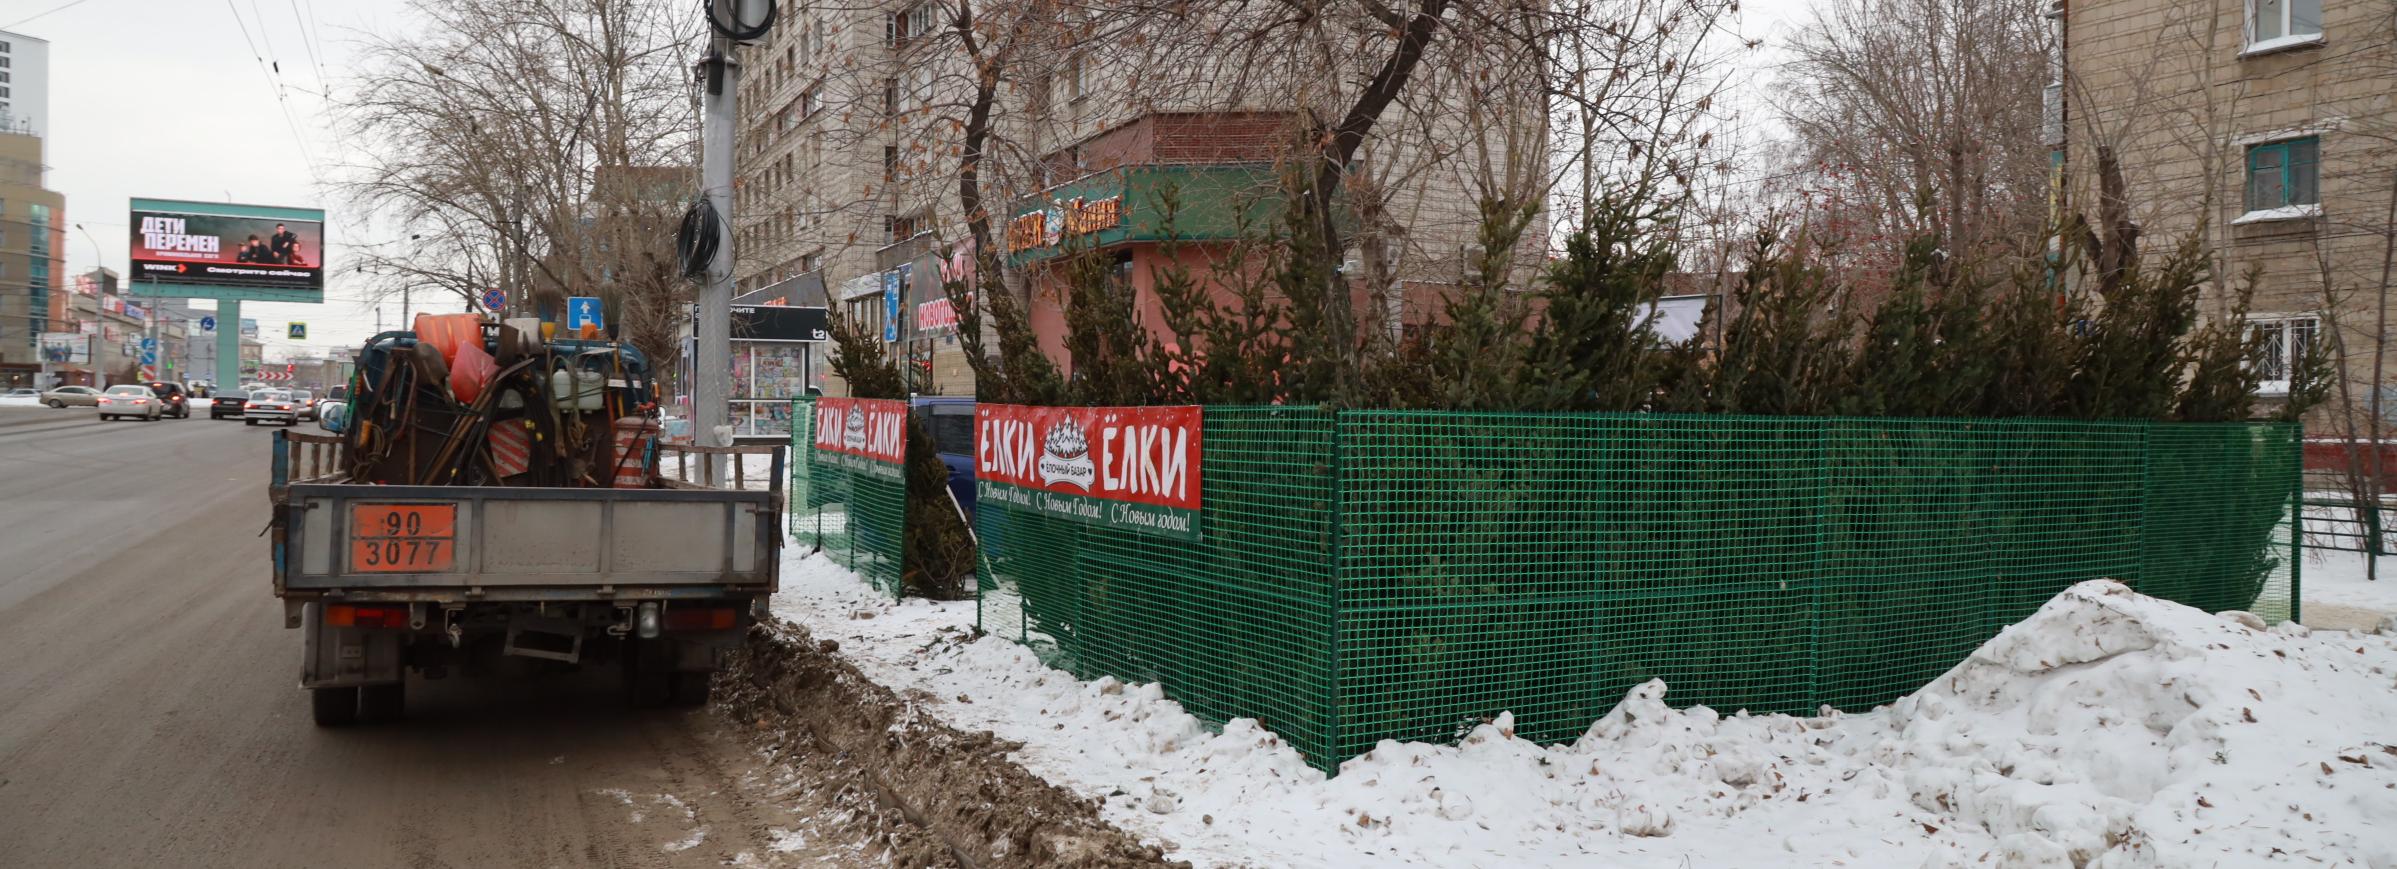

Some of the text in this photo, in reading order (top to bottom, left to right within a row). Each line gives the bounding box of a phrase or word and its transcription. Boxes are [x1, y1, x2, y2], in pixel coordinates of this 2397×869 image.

[140, 216, 186, 235] ДЕТИ
[144, 233, 220, 253] ПЕРЕМЕН
[143, 263, 178, 272] WINK
[206, 266, 311, 277] Смотрите сейчас
[812, 328, 825, 340] t2
[816, 400, 901, 459] ЁЛКИ ЁЛКИ
[980, 409, 1187, 502] ЁЛКИ ЁЛКИ
[1070, 463, 1087, 478] БАЗАР
[978, 481, 984, 499] С
[1036, 492, 1044, 511] С
[1043, 495, 1072, 515] Новым
[1072, 498, 1103, 520] Годом!
[1111, 502, 1119, 523] С
[1119, 504, 1156, 527] Новым
[1156, 507, 1190, 533] годом!
[386, 512, 421, 536] 90
[366, 540, 440, 566] 3077
